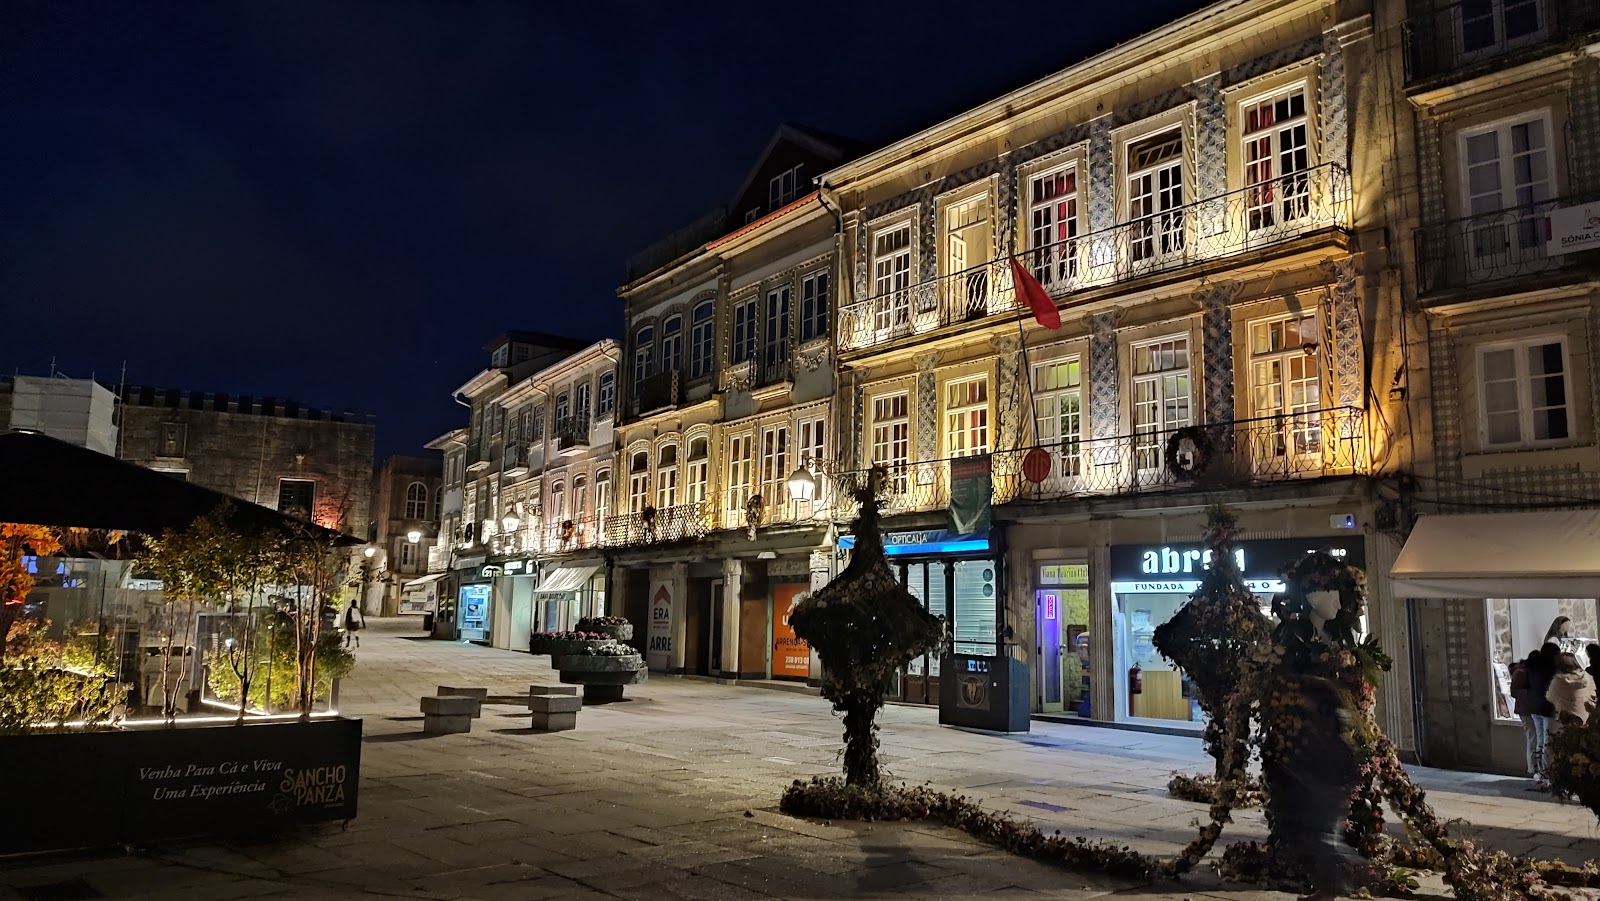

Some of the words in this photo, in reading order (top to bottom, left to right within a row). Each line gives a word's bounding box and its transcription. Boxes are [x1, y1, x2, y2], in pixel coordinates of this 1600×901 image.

[1561, 233, 1592, 245] SÓNIA
[1134, 582, 1185, 591] FUNDADA
[653, 607, 670, 620] ERA
[649, 635, 672, 652] ARRE
[139, 764, 182, 780] Venha
[184, 763, 216, 778] Para
[219, 761, 239, 775] Cá
[241, 764, 249, 773] e
[253, 758, 282, 773] Viva
[280, 765, 346, 793] SANCHO
[153, 786, 187, 801] Uma
[189, 779, 267, 800] Experiência
[293, 784, 345, 806] PANZA
